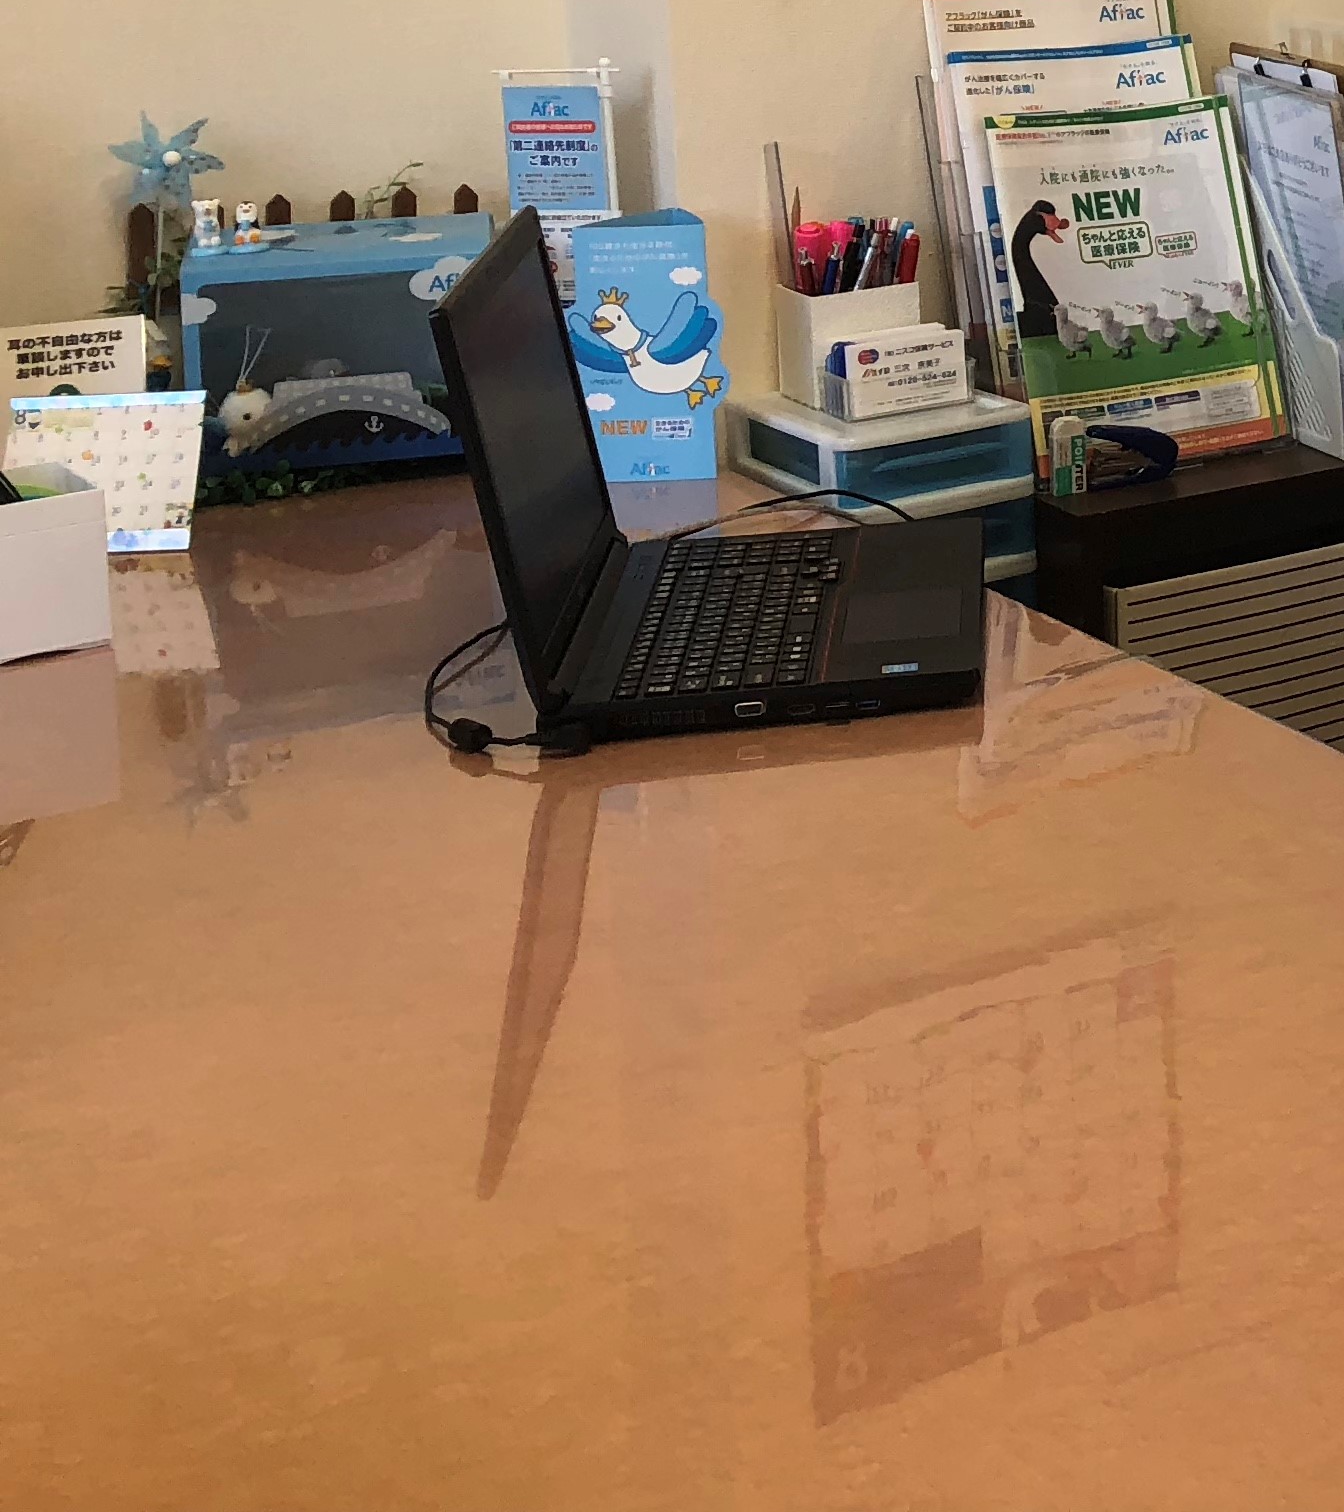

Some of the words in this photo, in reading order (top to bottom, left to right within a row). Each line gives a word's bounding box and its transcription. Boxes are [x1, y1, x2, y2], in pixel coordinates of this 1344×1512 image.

[529, 155, 578, 167] ご案内です
[1071, 187, 1141, 223] NEW
[1081, 228, 1146, 245] ちゃんと応える
[1091, 240, 1141, 258] 医療保険
[1112, 259, 1135, 270] EVER
[7, 329, 124, 351] 耳の不自由な方は
[16, 345, 115, 365] 筆談しますので
[16, 360, 116, 380] お申し出下さい
[600, 420, 648, 436] NEW
